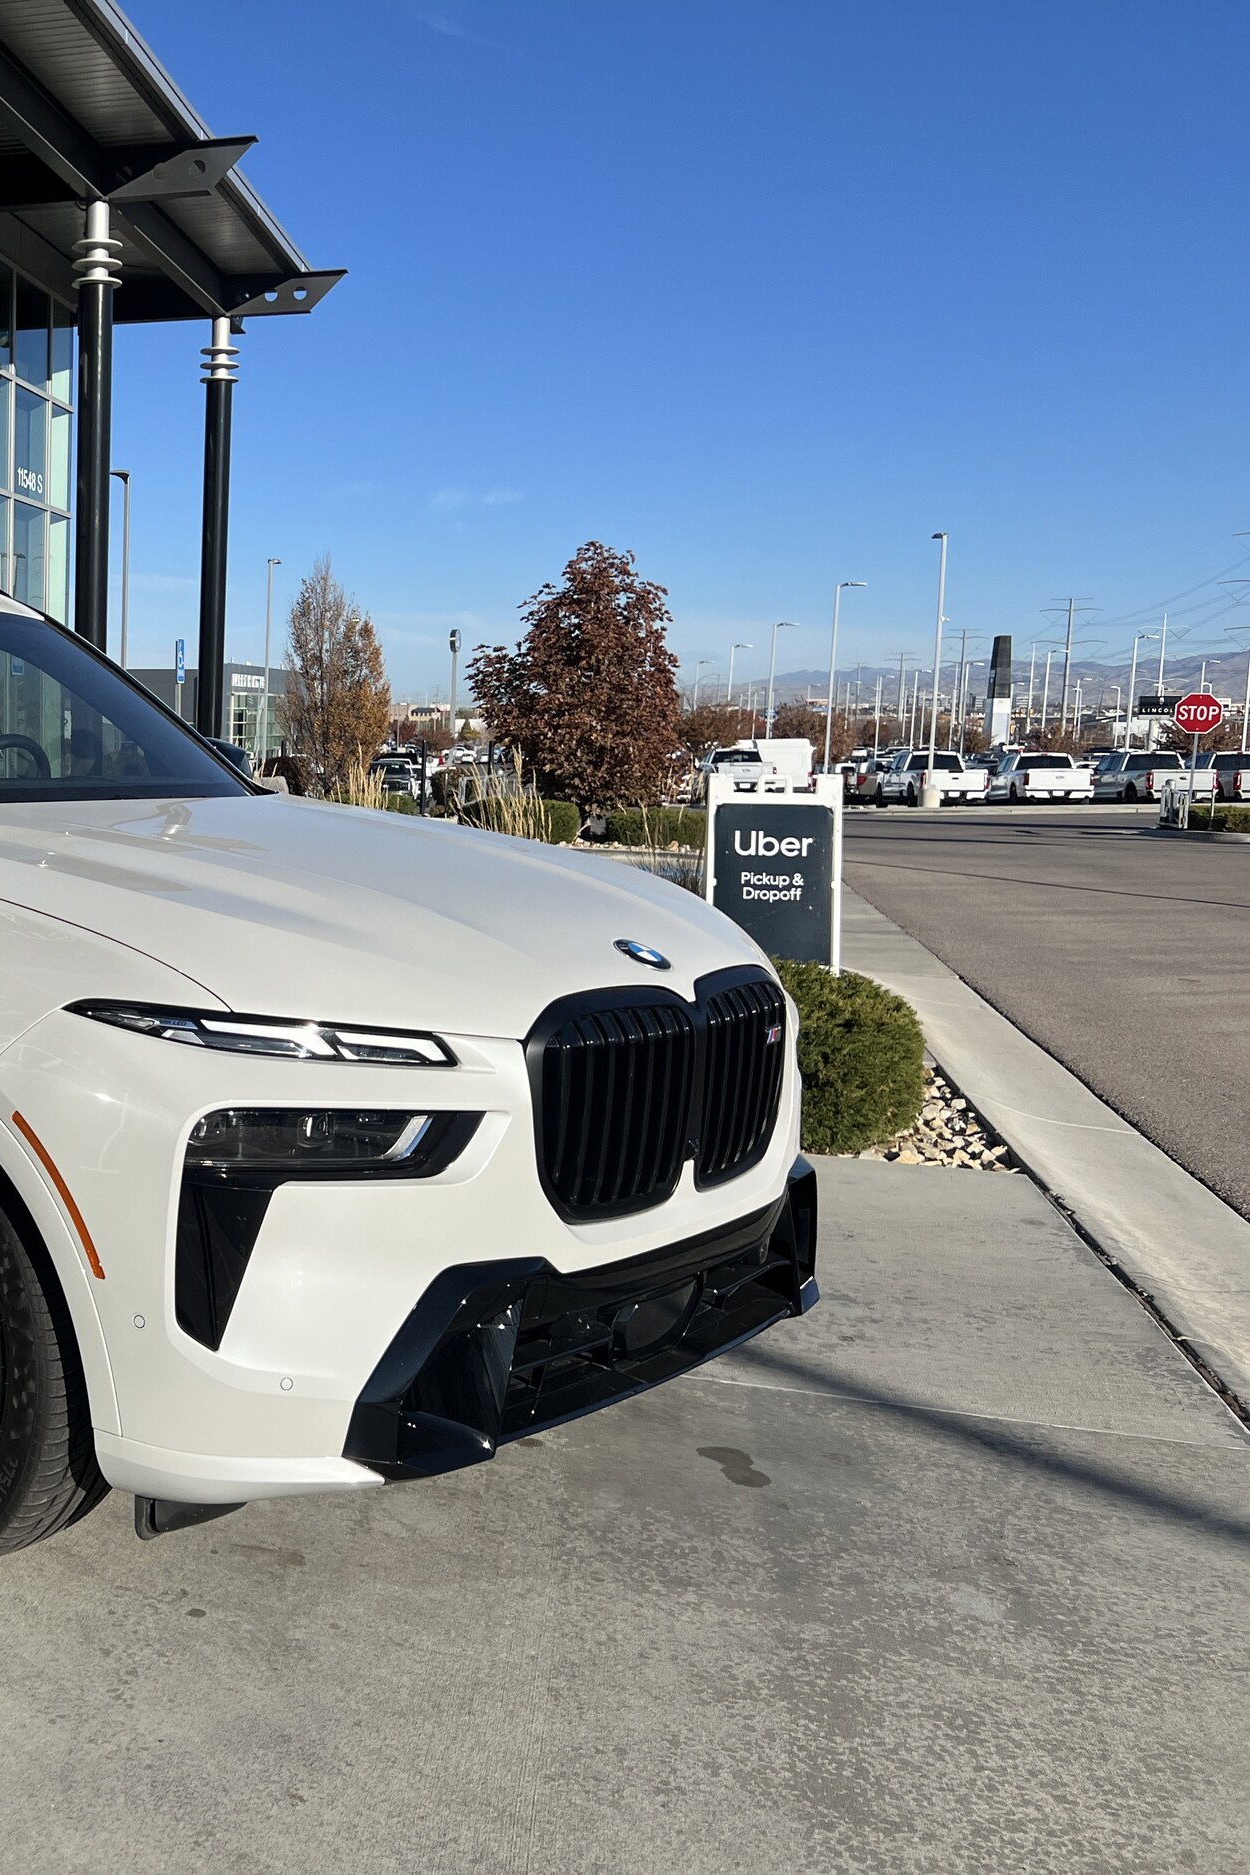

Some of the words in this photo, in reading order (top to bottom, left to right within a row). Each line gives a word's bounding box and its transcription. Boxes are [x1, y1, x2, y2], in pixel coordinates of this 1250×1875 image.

[17, 466, 36, 491] 11548
[37, 474, 43, 494] S
[1178, 705, 1220, 721] STOP
[734, 830, 813, 857] Uber
[740, 871, 790, 888] Pickup
[792, 872, 804, 886] &
[742, 886, 802, 903] Dropoff
